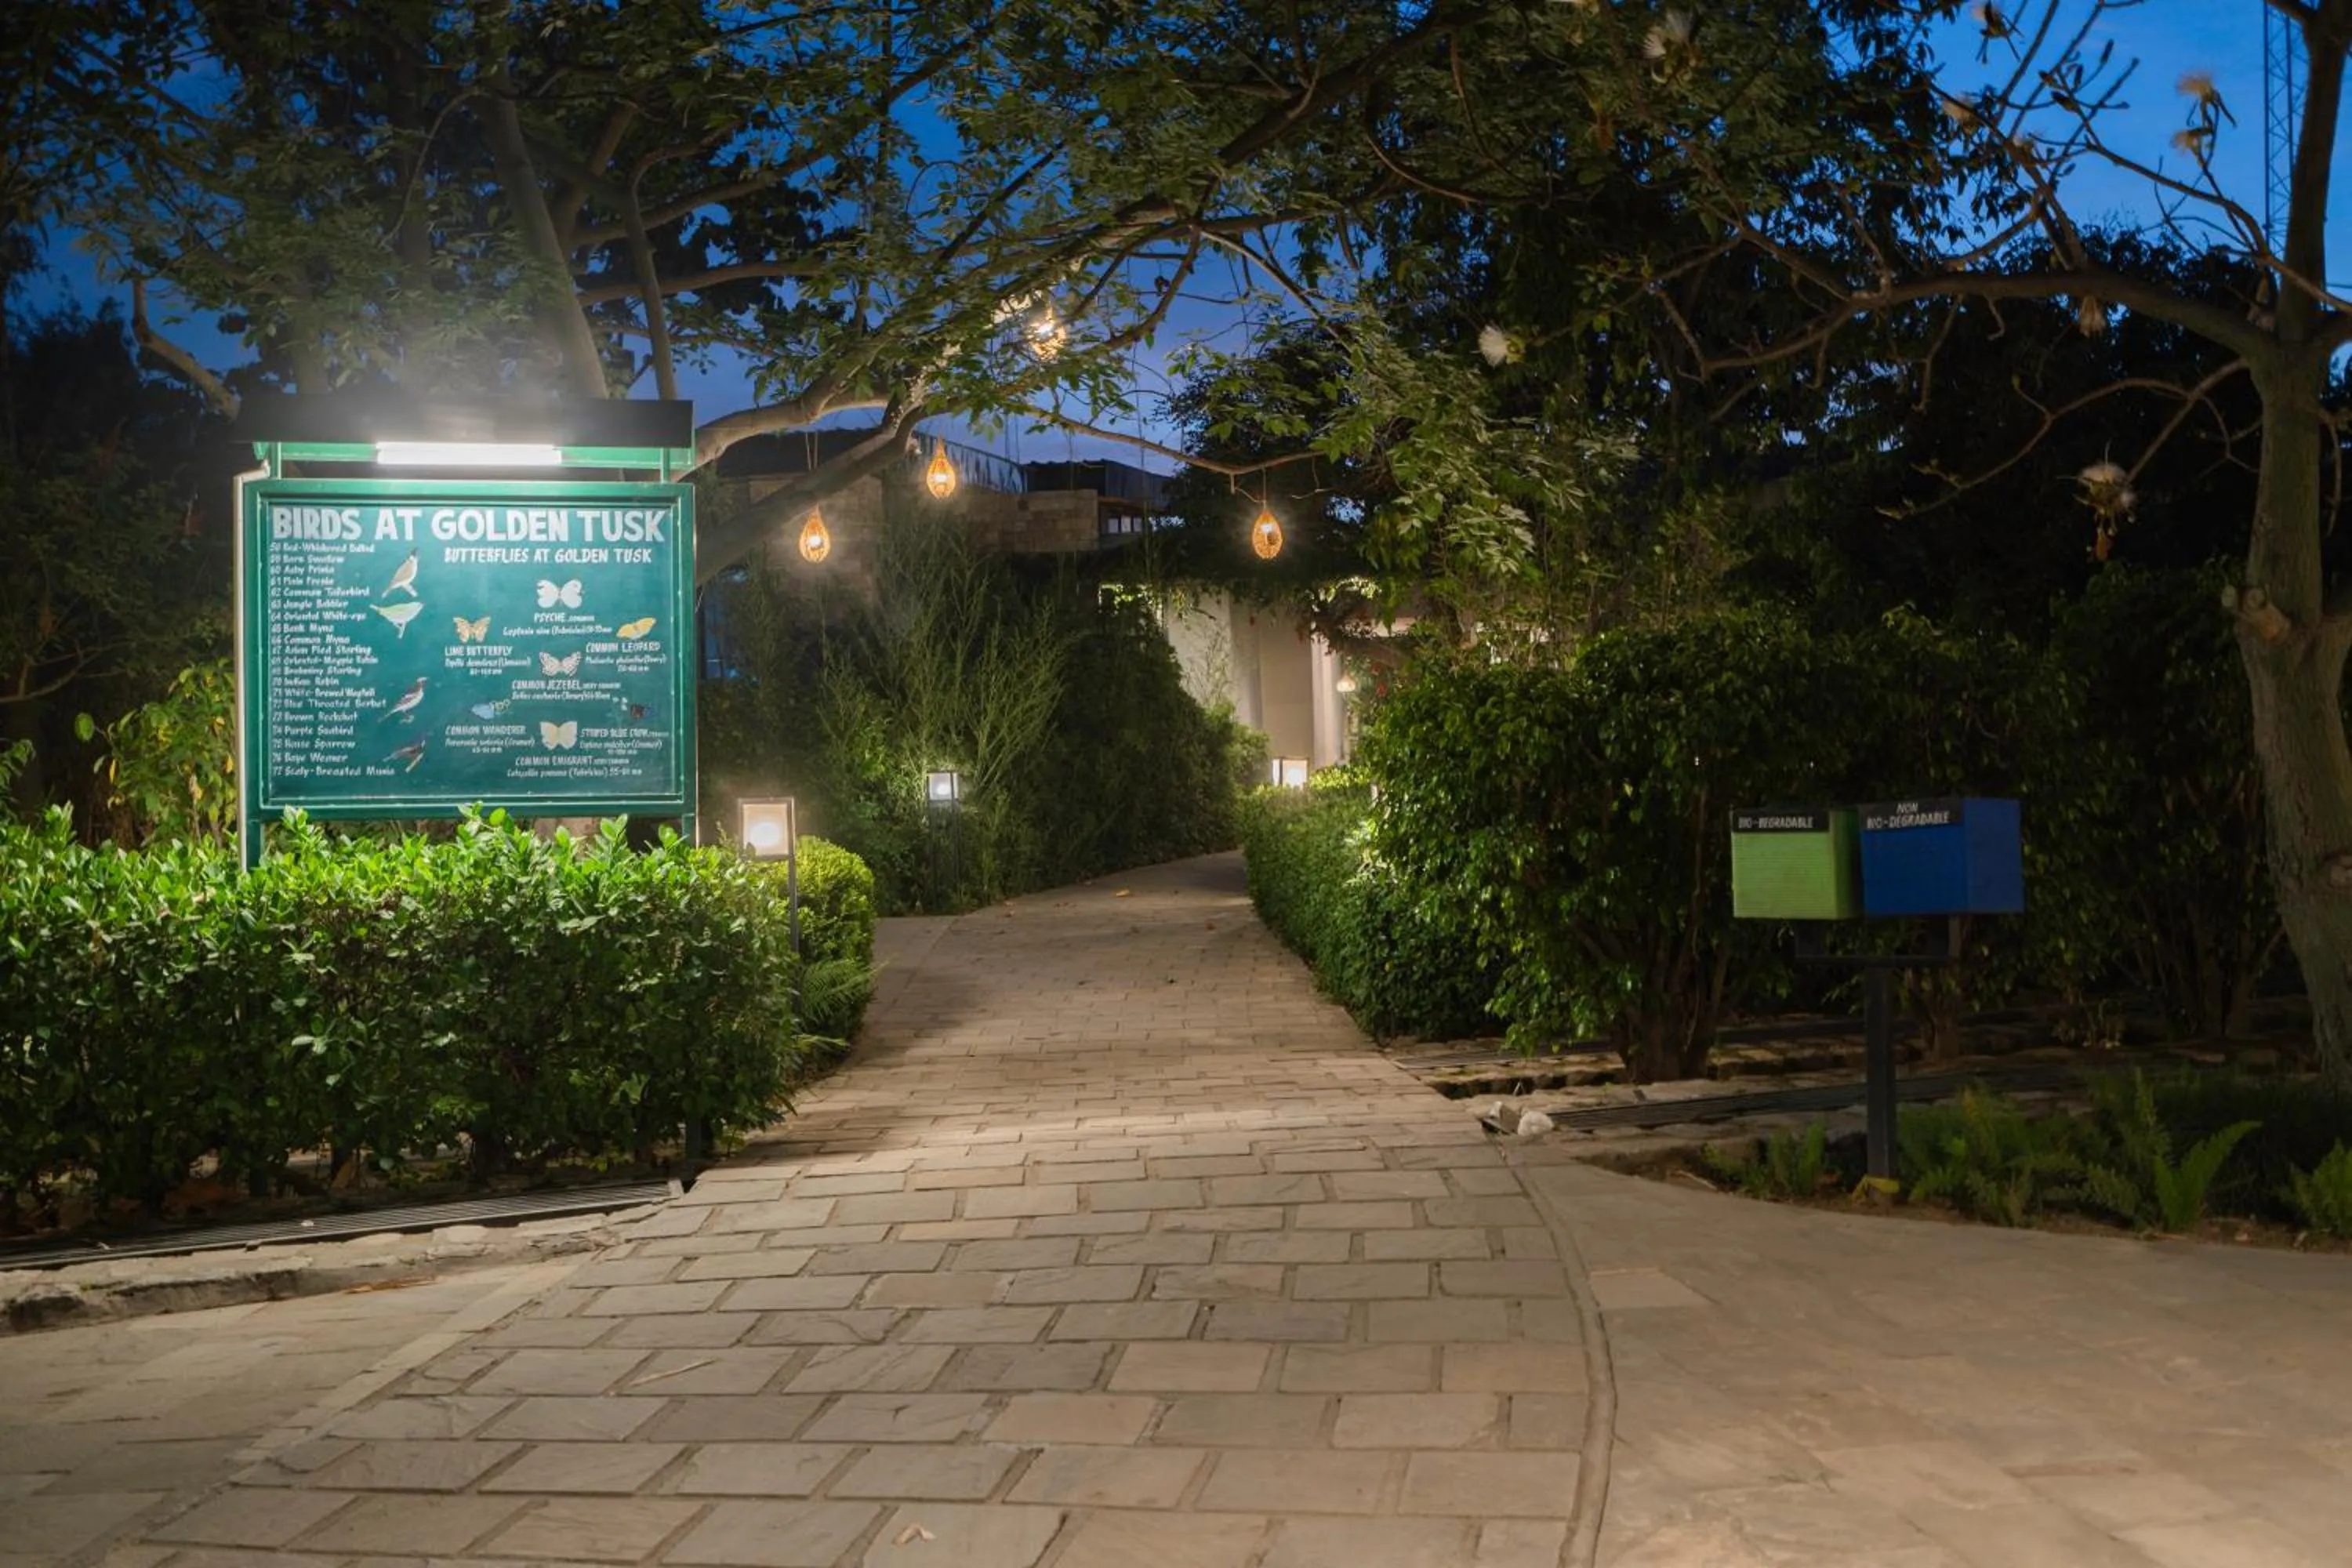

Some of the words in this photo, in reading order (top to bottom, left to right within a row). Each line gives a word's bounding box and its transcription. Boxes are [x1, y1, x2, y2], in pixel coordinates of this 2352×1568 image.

[272, 508, 361, 540] BIRDS
[375, 509, 422, 540] AT
[431, 508, 568, 541] GOLDEN
[577, 510, 666, 543] TUSK
[445, 548, 528, 563] BUTTERFLIES
[534, 548, 550, 563] AT
[554, 548, 608, 563] GOLDEN
[615, 548, 652, 564] TUSK
[534, 612, 566, 622] PSYCHE
[445, 645, 465, 656] LIME
[466, 645, 514, 656] BUTTERFLY
[586, 642, 619, 653] COMMON
[622, 641, 660, 652] LEOPARD
[512, 680, 546, 690] COMMON
[546, 680, 581, 690] JEZEBEL
[445, 725, 480, 735] COMMON
[482, 725, 526, 735] WANDERER
[314, 737, 356, 750] Sparrow
[515, 756, 550, 766] COMMON
[552, 755, 593, 766] EMIGRANT
[1896, 802, 1918, 814] NON
[1866, 811, 1950, 829] BIO-DEGRADABLE
